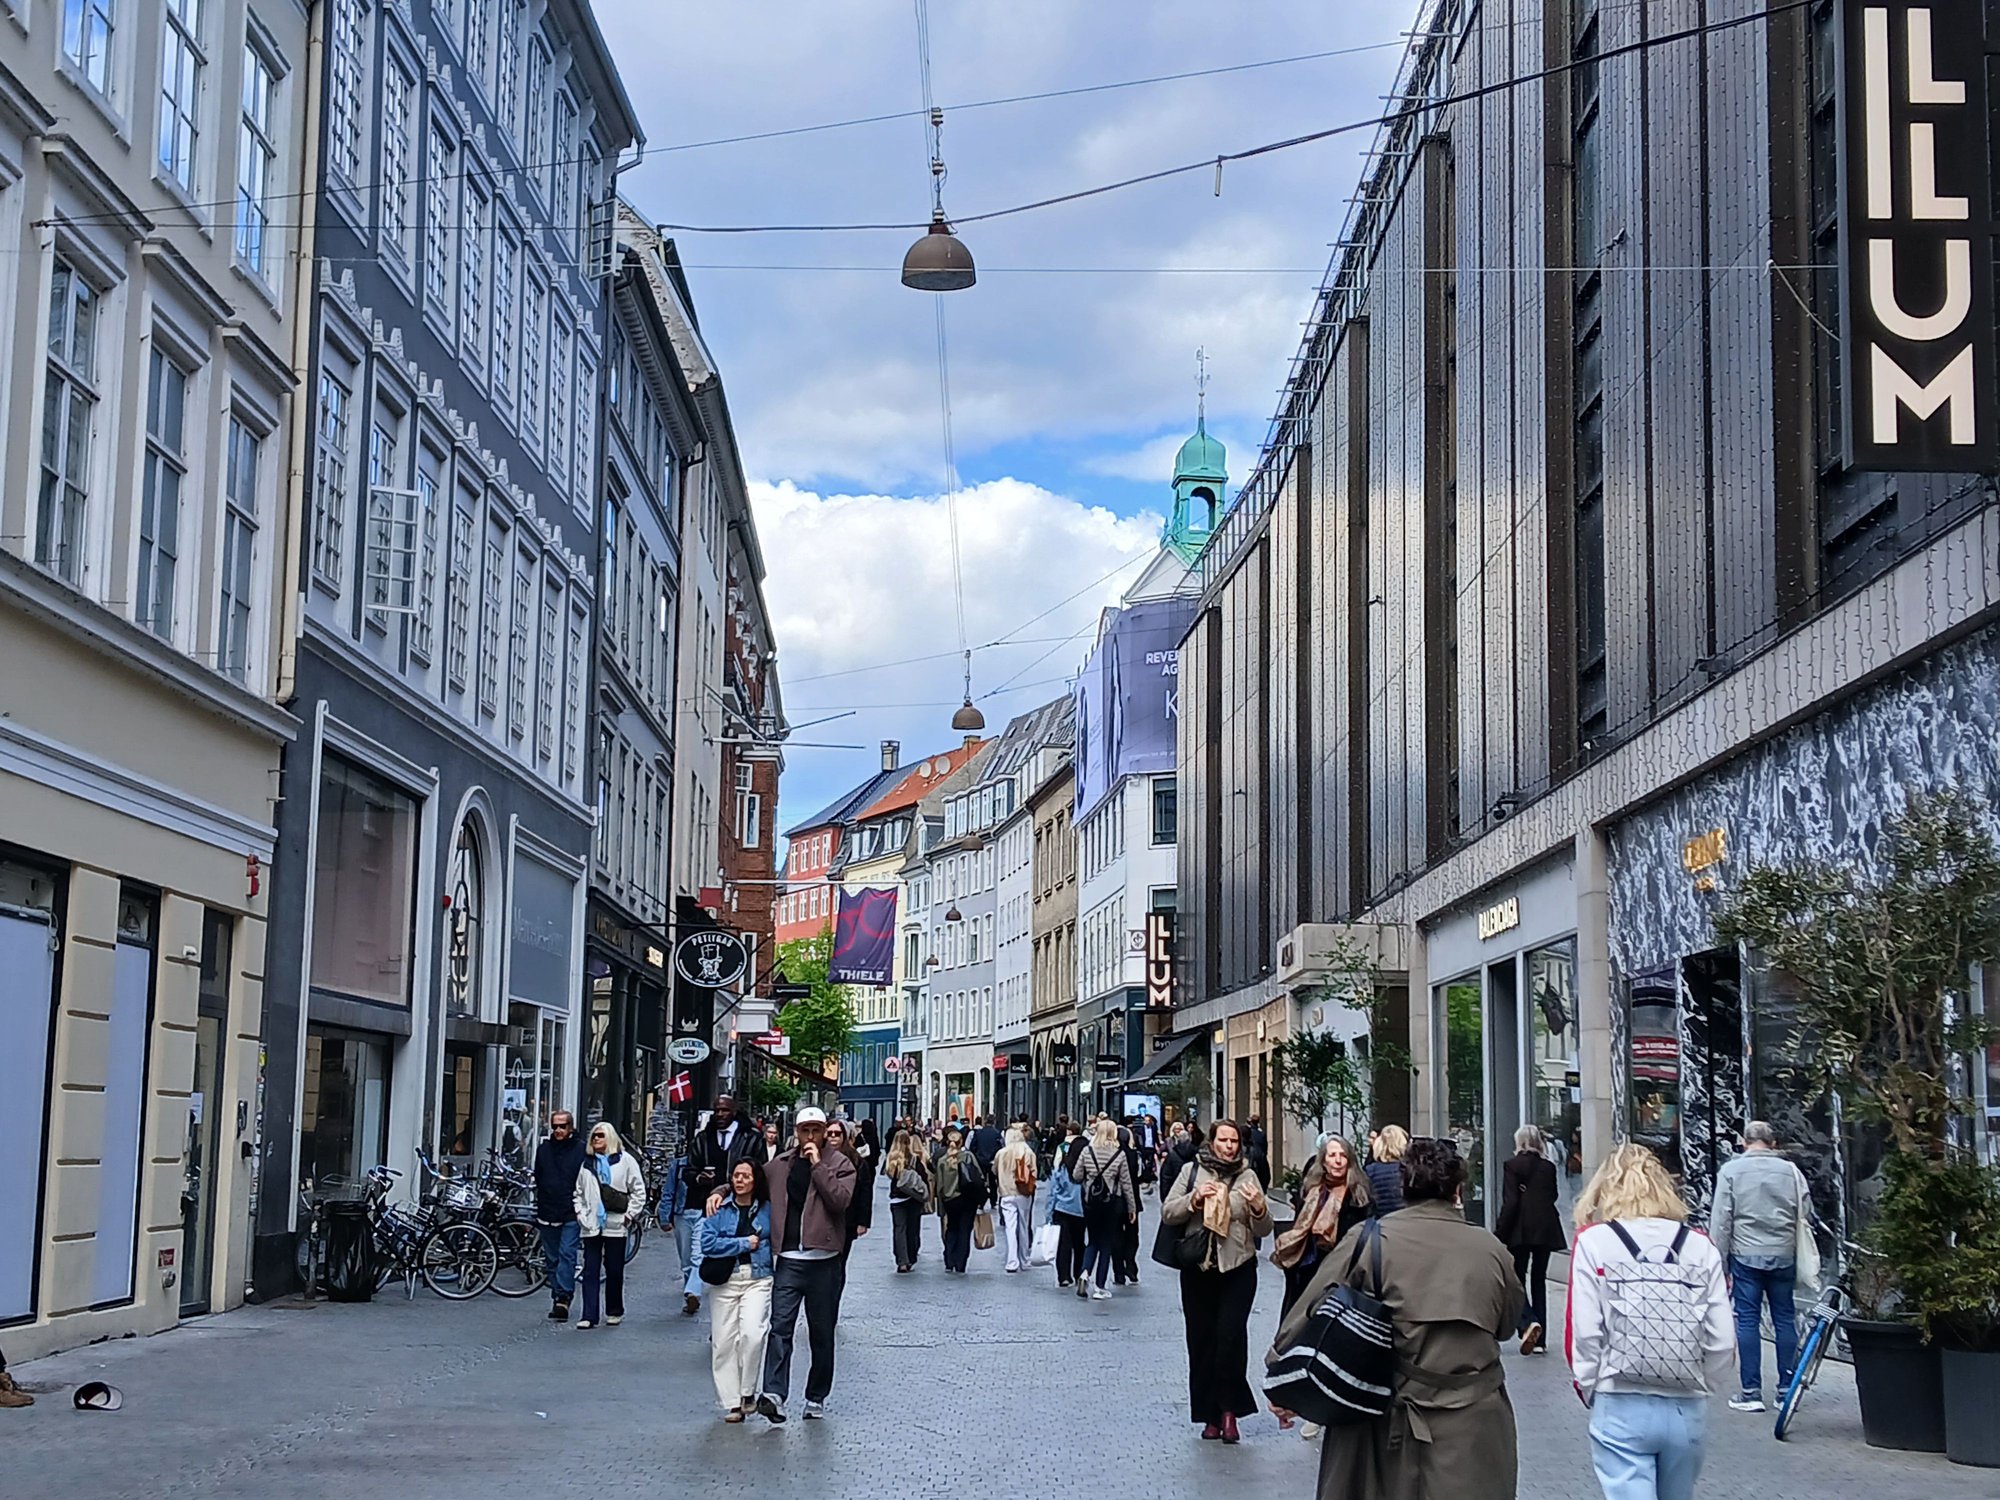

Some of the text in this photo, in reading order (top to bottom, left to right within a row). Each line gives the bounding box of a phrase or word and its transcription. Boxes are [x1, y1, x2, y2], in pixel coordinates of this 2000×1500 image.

[1864, 7, 1975, 444] ILLUM
[838, 969, 885, 981] THIELE
[1149, 916, 1170, 1006] ILLUM
